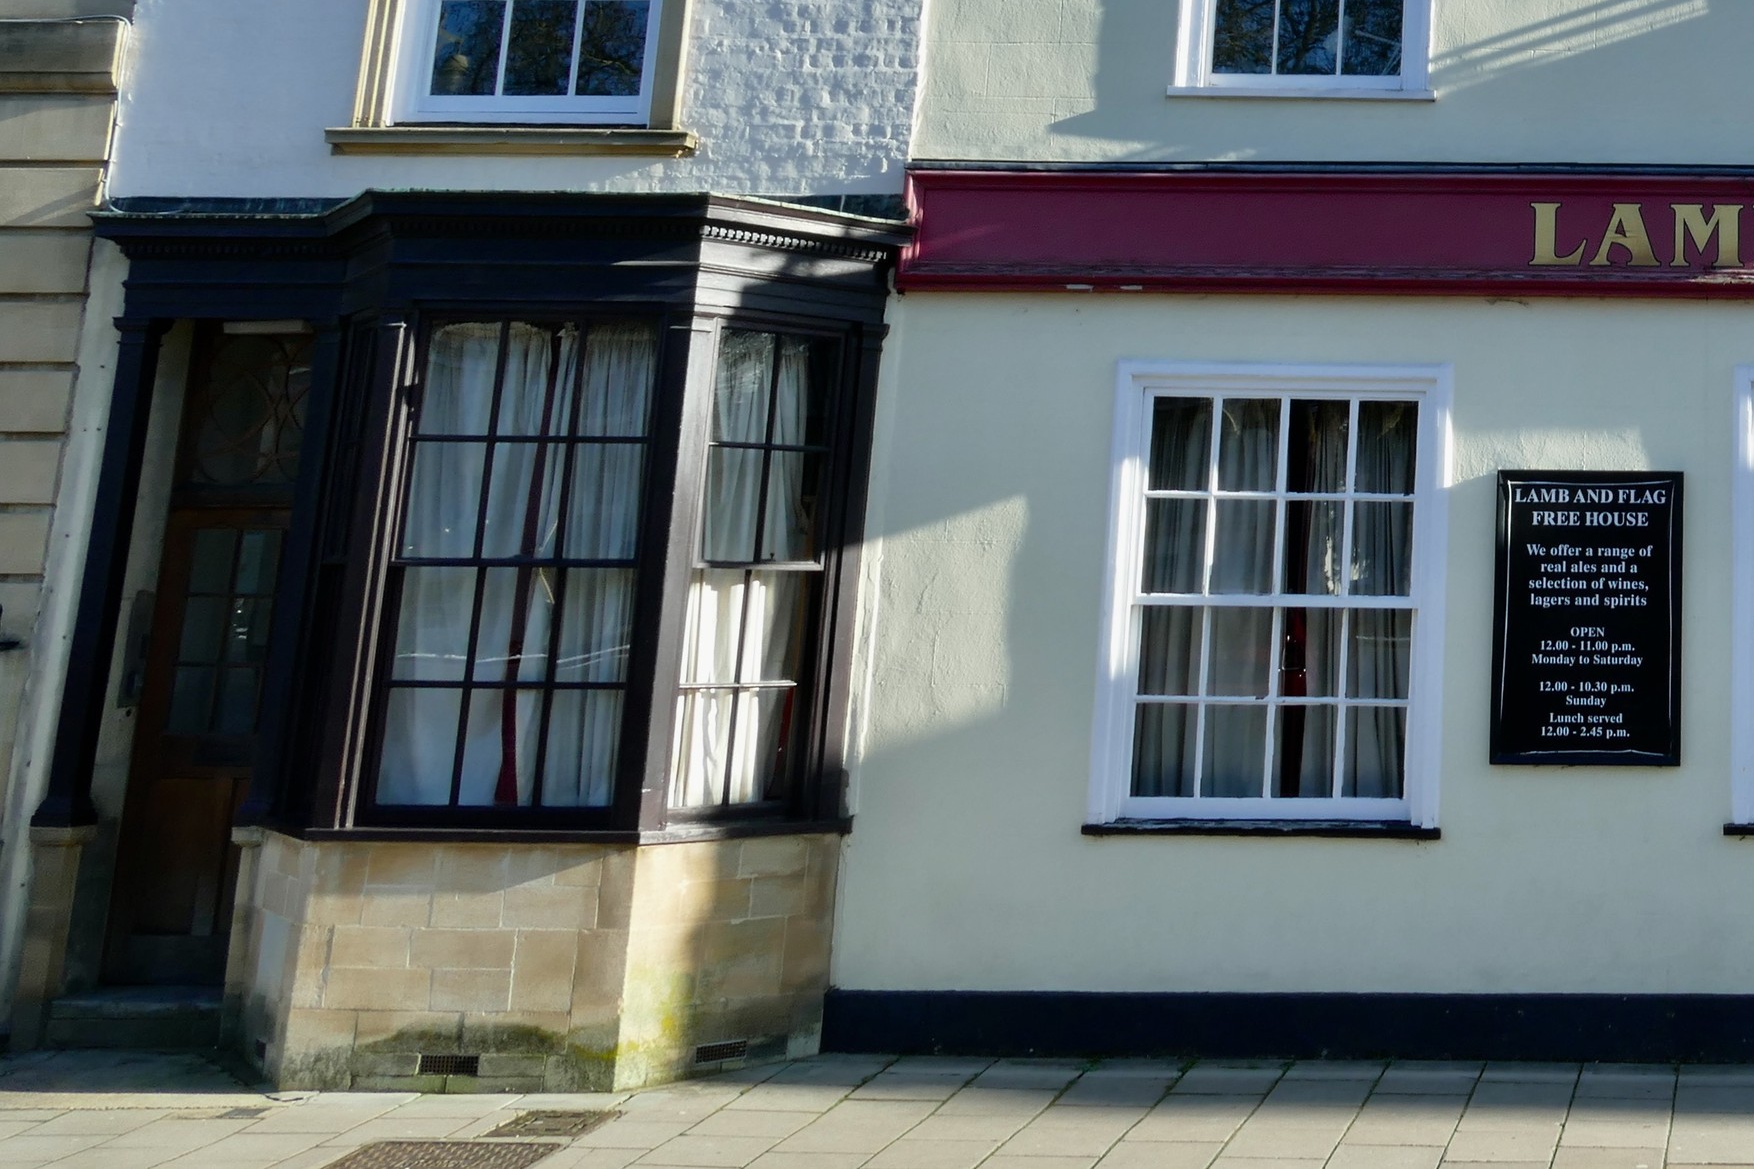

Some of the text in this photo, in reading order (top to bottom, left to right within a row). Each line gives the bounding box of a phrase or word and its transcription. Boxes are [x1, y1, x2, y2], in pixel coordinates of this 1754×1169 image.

[1514, 488, 1667, 504] LAMB AND FLAG
[1531, 510, 1649, 527] FREE HOUSE
[1526, 543, 1654, 560] We offer a range of
[1540, 560, 1638, 574] real ales and a
[1528, 576, 1650, 592] selection of wines,
[1530, 592, 1648, 609] lagers and spirits
[1570, 626, 1605, 638] OPEN
[1540, 640, 1569, 652] 12.00
[1580, 640, 1609, 652] 11.00
[1611, 642, 1636, 654] p.m.
[1531, 653, 1644, 666] Monday to Saturday
[1539, 681, 1568, 693] 12.00
[1579, 681, 1608, 693] 10.30
[1610, 684, 1635, 696] p.m.
[1565, 694, 1607, 708] Sunday
[1549, 712, 1623, 724] Lunch served
[1540, 725, 1570, 737] 12.00
[1579, 725, 1604, 737] 2.45
[1606, 727, 1631, 739] p.m.
